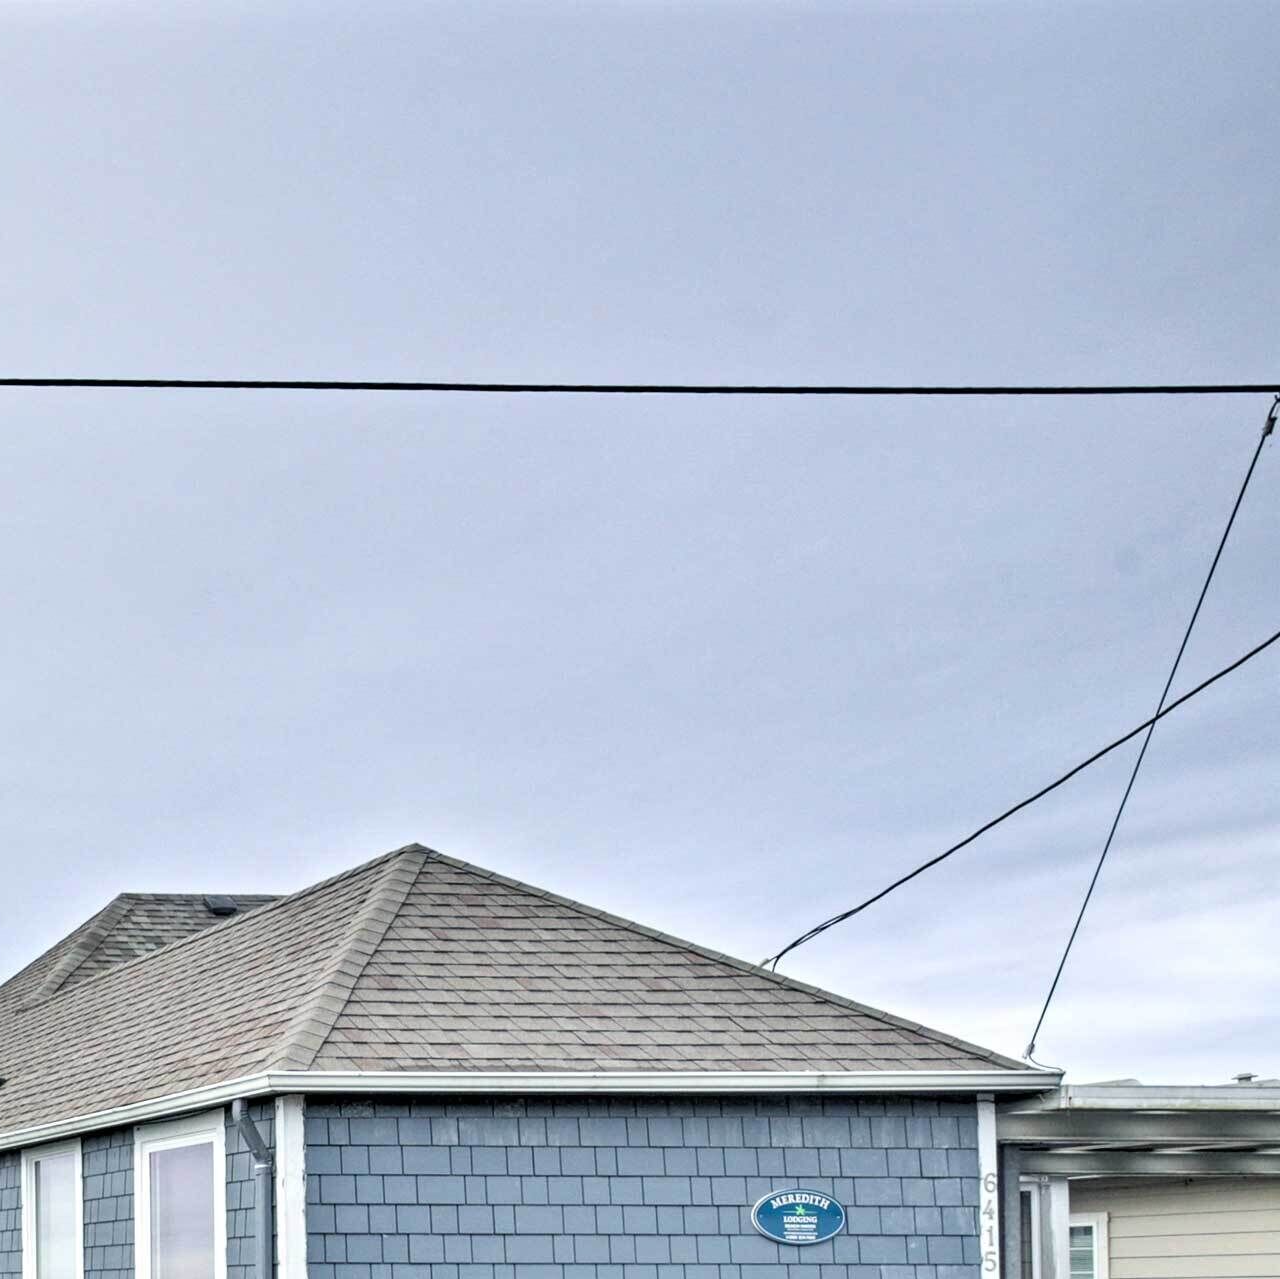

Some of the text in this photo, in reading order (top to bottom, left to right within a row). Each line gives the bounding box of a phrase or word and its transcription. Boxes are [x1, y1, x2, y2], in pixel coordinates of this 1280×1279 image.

[770, 1193, 830, 1210] MEREDITH
[783, 1216, 818, 1224] LODGING
[982, 1173, 997, 1272] 6415
